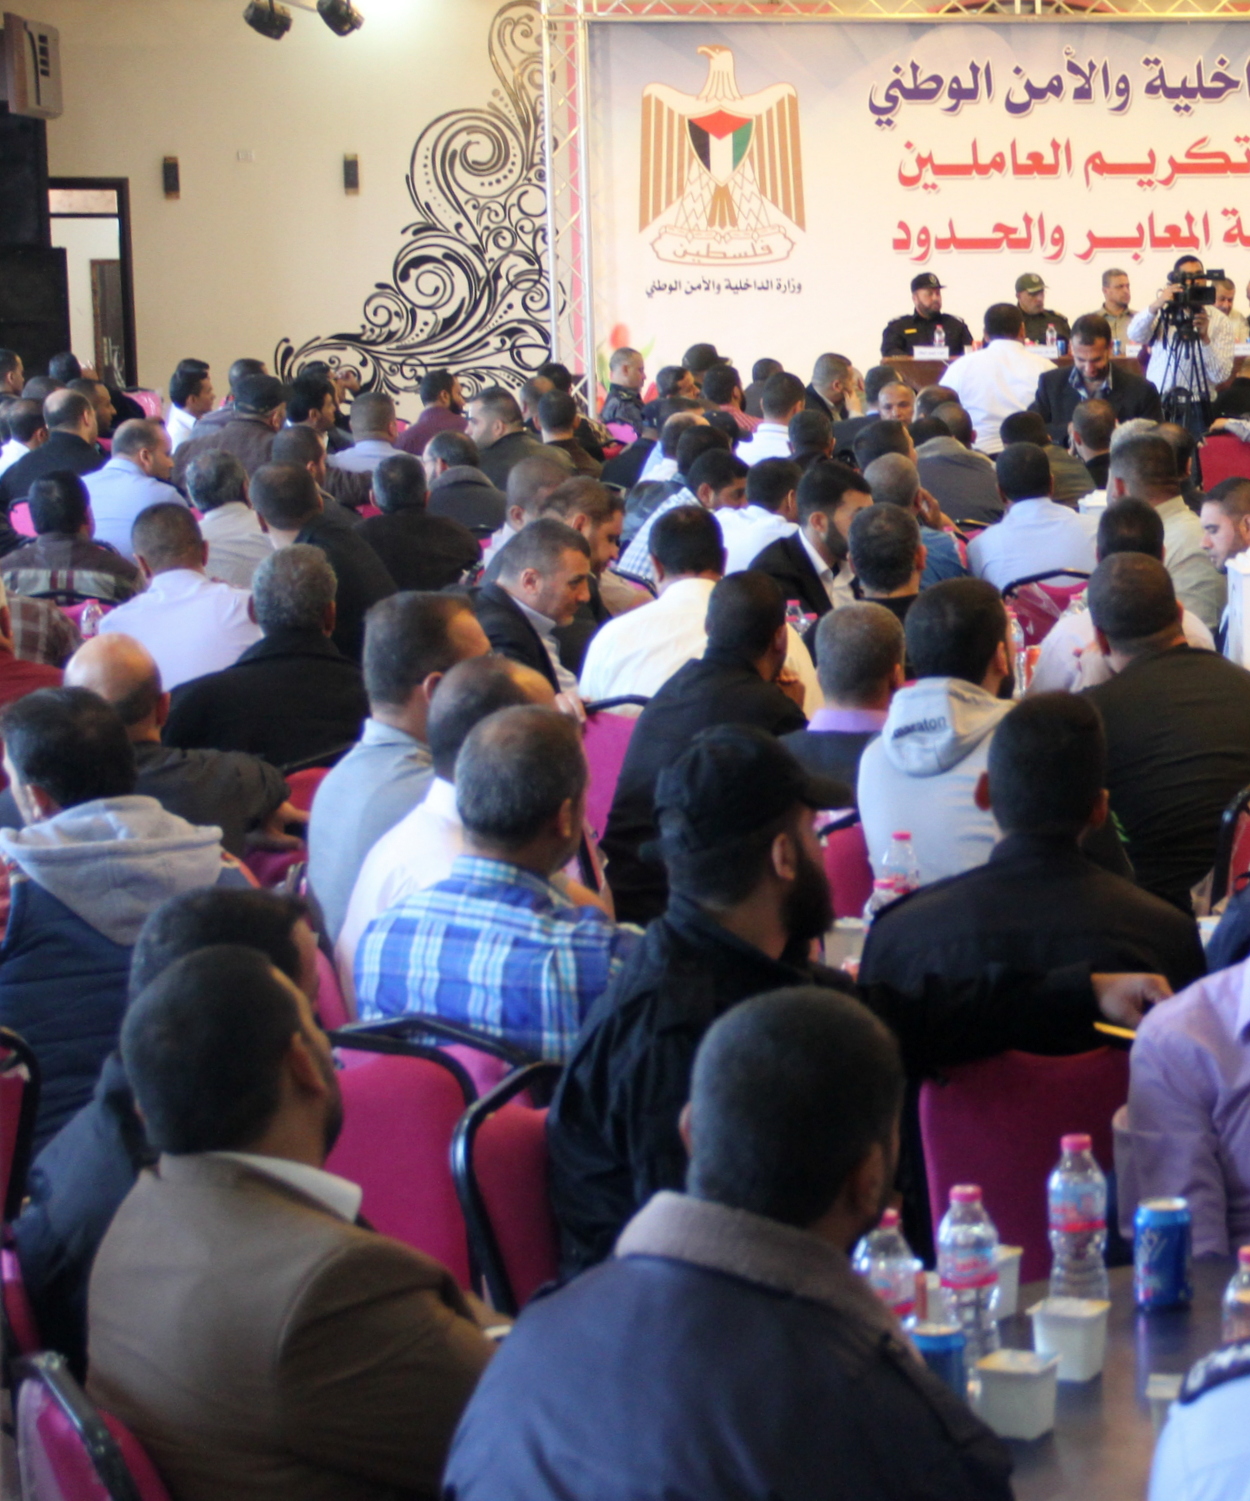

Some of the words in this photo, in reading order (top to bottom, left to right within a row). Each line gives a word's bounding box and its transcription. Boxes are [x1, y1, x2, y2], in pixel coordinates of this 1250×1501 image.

[868, 60, 993, 128] الوطني
[1004, 46, 1131, 114] والأمن
[897, 138, 1073, 192] العاملين
[672, 239, 774, 264] فلسطين
[892, 212, 1066, 263] والحدود
[1074, 211, 1211, 264] المعابر
[645, 278, 682, 299] الوطني
[684, 275, 722, 296] والأمن
[724, 278, 774, 295] الداخلية
[776, 278, 803, 294] وزارة
